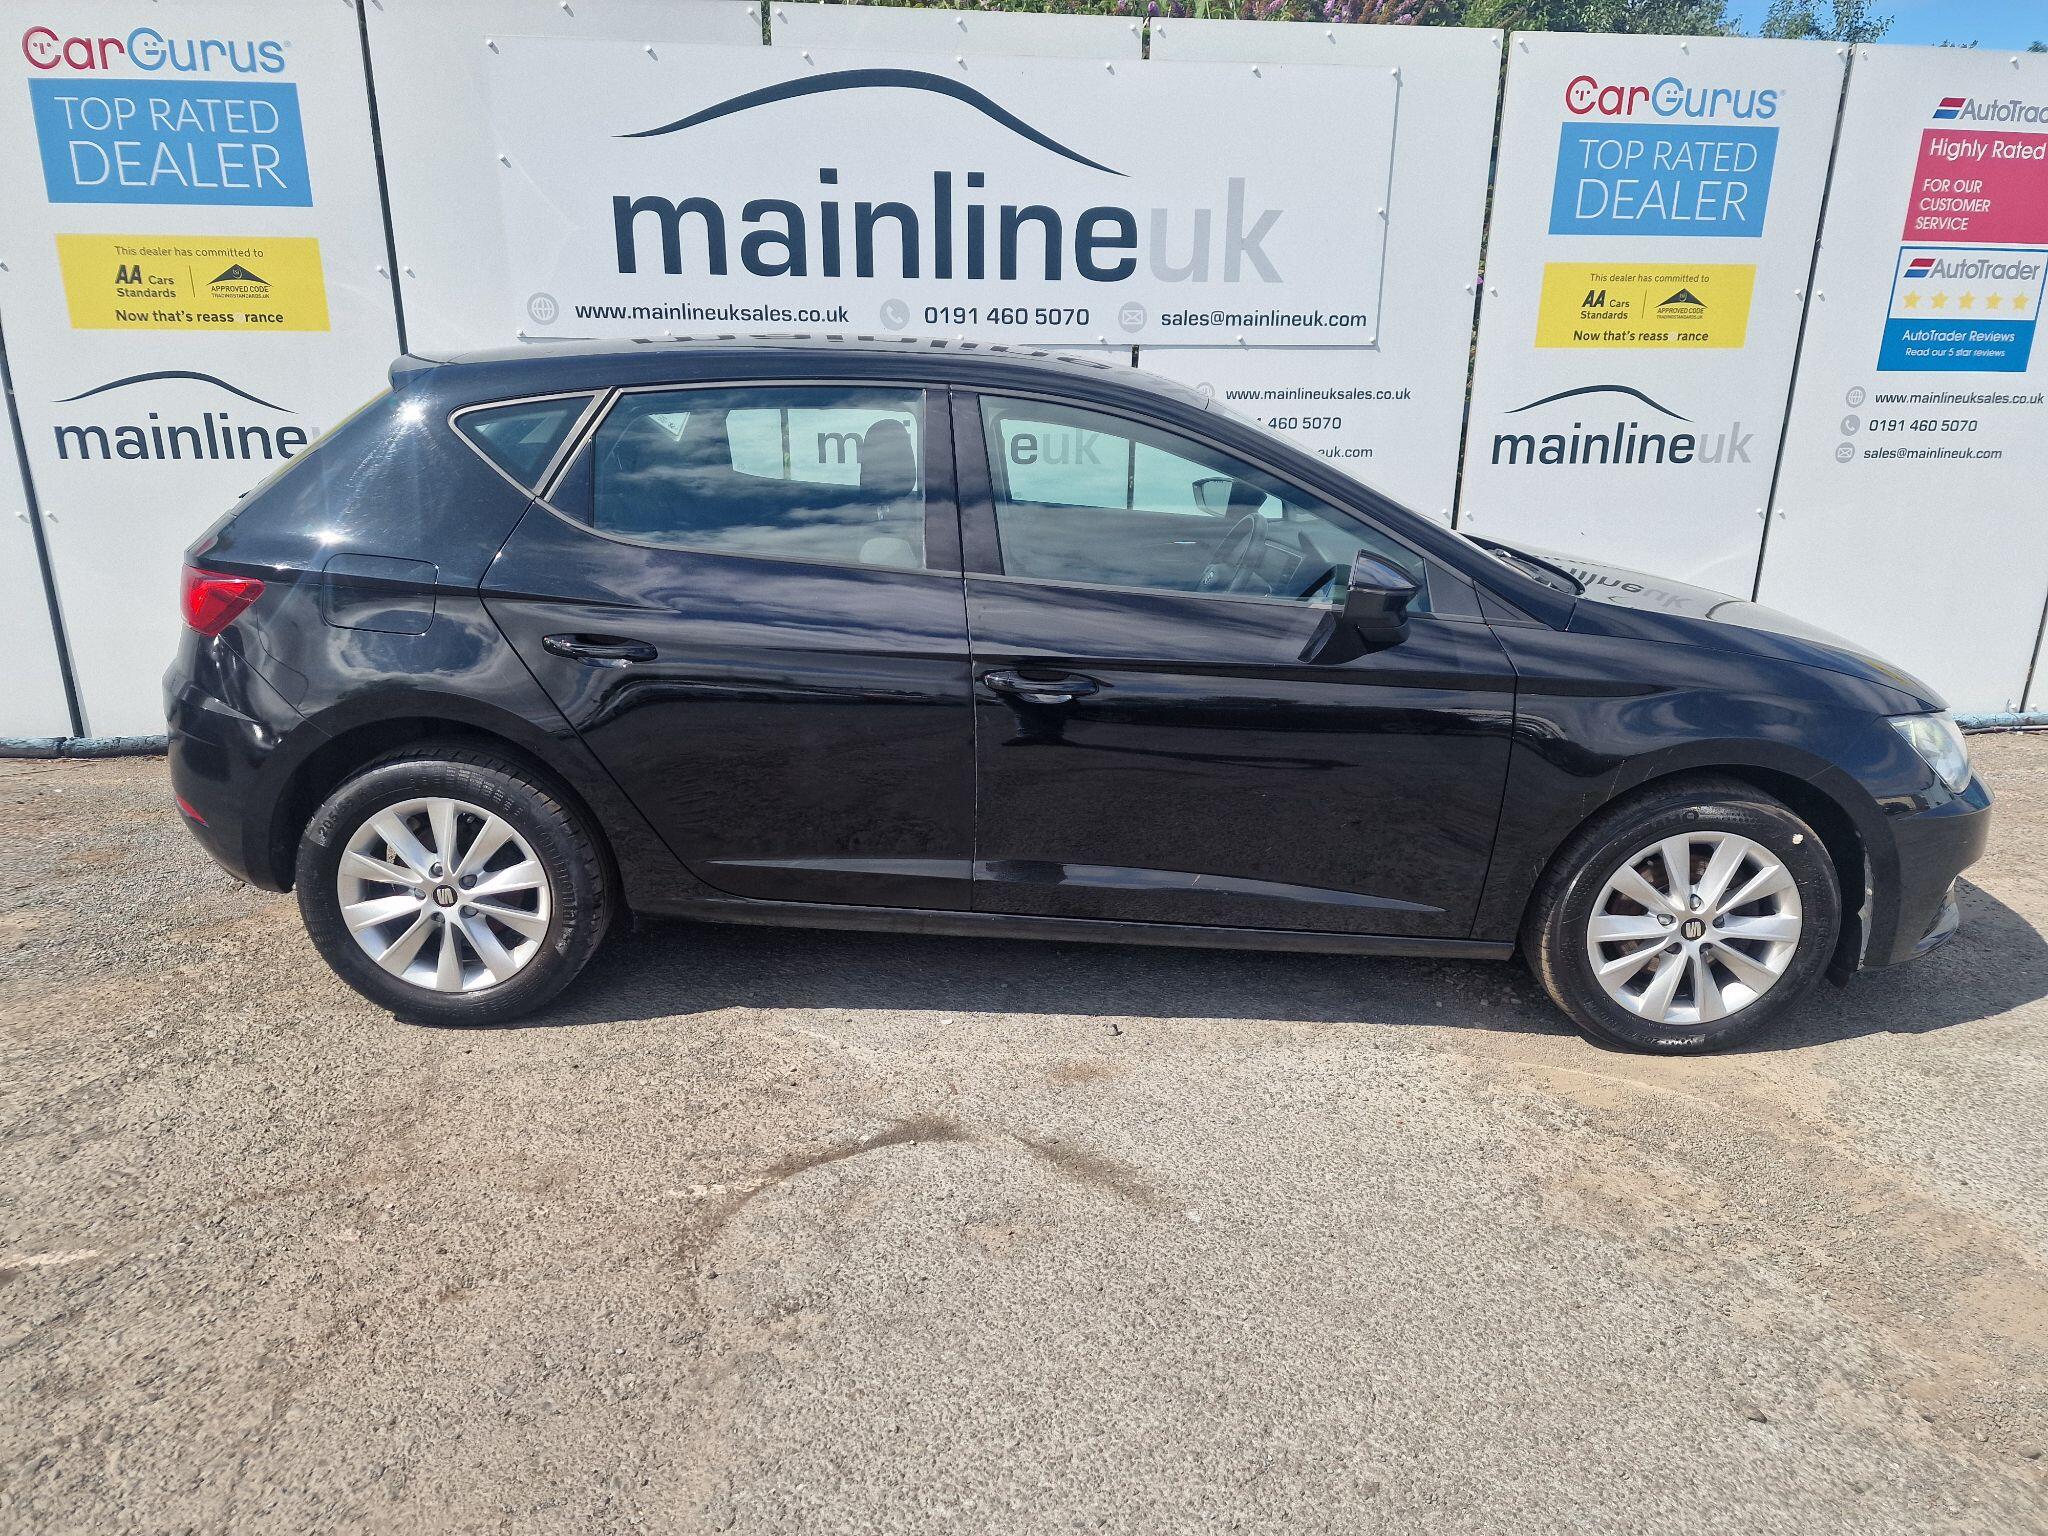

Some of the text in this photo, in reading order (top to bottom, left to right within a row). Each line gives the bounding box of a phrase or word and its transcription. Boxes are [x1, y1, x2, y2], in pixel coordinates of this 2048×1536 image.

[54, 96, 280, 134] TOP RATED
[1579, 139, 1758, 173] TOP RATED
[1929, 138, 2047, 161] Highly Rated
[68, 140, 288, 189] DEALER
[1922, 178, 1983, 193] FOR OUR
[1575, 178, 1748, 221] DEALER
[1920, 197, 1991, 212] CUSTOMER
[612, 168, 1285, 282] mainlineuk
[1915, 216, 1969, 230] SERVICE
[114, 245, 264, 258] This dealer has committed to
[115, 264, 175, 285] AA Cars
[1929, 258, 2041, 281] AutoTrader
[1590, 273, 1710, 283] This dealer has committed to
[116, 287, 177, 298] Standards
[211, 285, 270, 293] APPROVED CODE
[1581, 289, 1630, 308] AA Cars
[115, 309, 284, 323] Now that's reassrance
[575, 302, 850, 322] www.mainlineuksales.co.uk
[924, 306, 1090, 326] 0191 460 5070
[1580, 310, 1628, 320] Standards
[1688, 307, 1705, 315] CODE
[1161, 309, 1367, 328] sales@mainlineuk.com
[1573, 329, 1709, 342] Now that's reassrance
[1902, 329, 2016, 343] AutoTrader Reviews
[1905, 347, 2006, 357] Read our 5 star reviews
[1225, 387, 1412, 400] www.mainlineuksales.co.uk
[1875, 391, 2045, 405] www.mainlineuksales.co.uk
[1267, 416, 1342, 430] 460 5070
[1869, 419, 1978, 432] 0191 460 5070
[1491, 421, 1754, 465] mainlineuk
[1863, 447, 2003, 459] sales@mainlineuk.com
